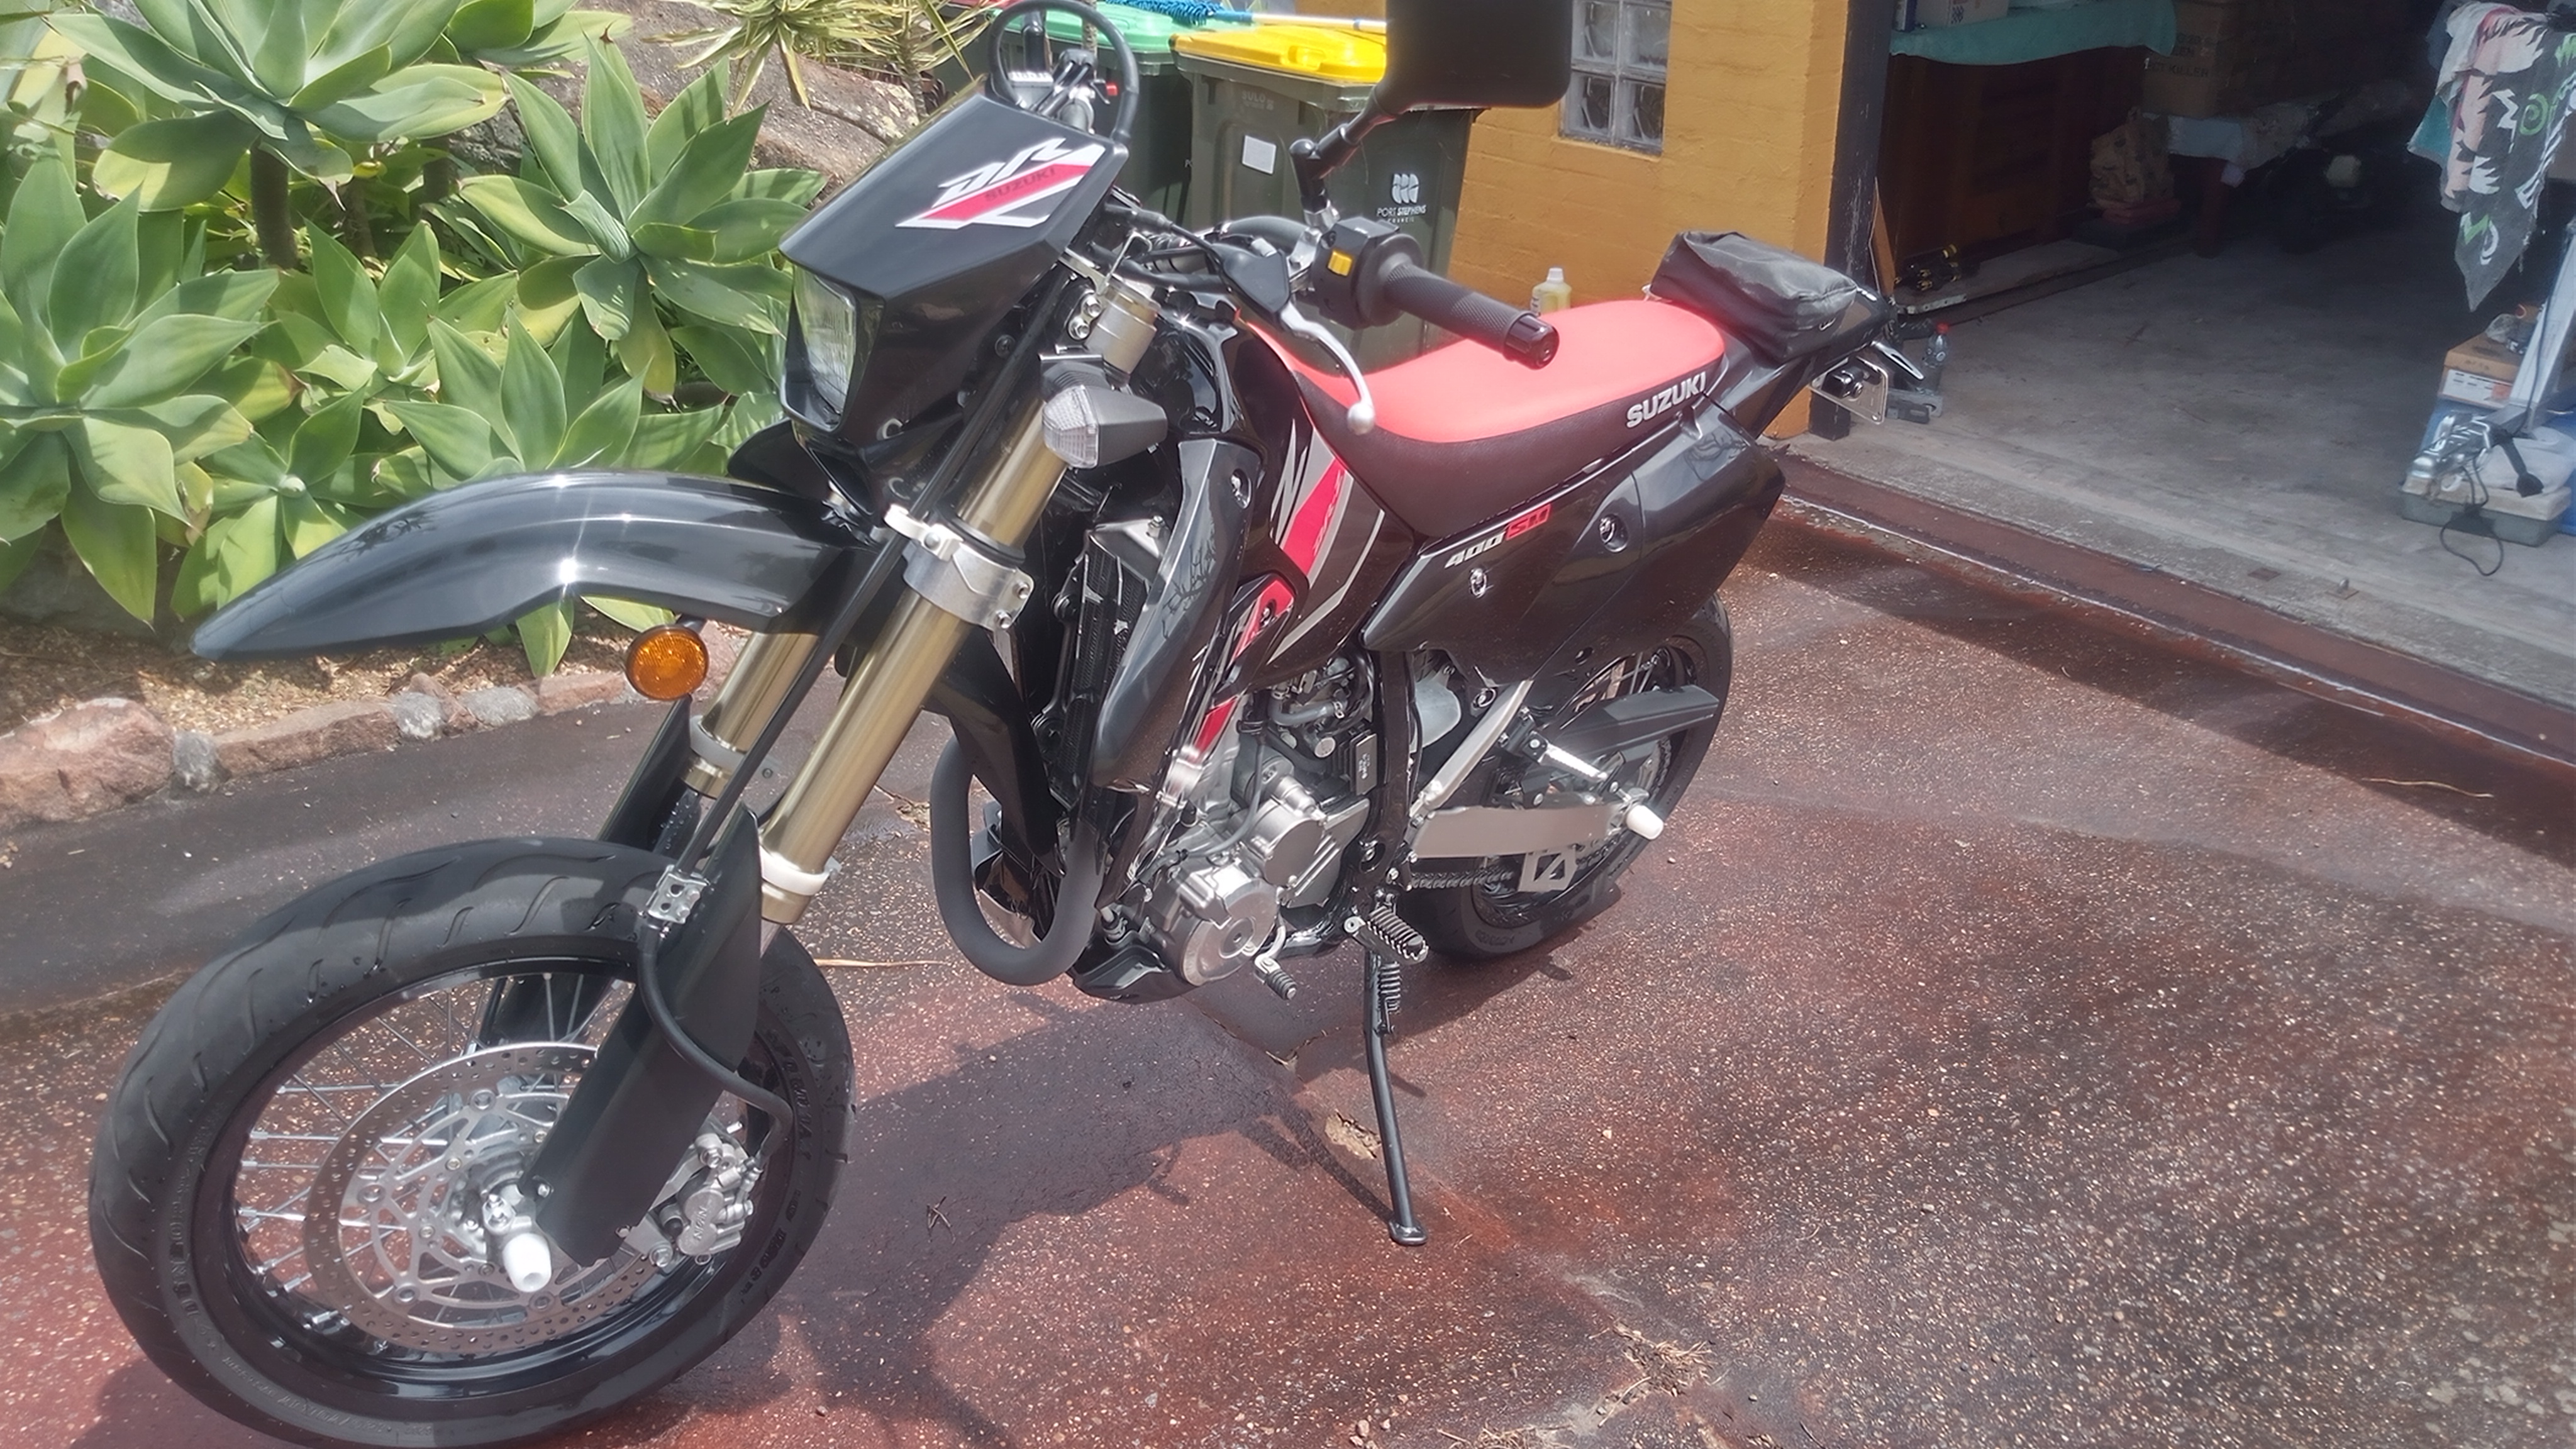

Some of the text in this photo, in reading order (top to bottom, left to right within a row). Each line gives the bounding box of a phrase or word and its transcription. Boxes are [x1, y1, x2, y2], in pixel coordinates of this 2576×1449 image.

[2169, 64, 2209, 78] KILLER
[1241, 90, 1266, 103] SULO
[984, 167, 1056, 202] SUZUKI
[1377, 204, 1426, 217] PORT STEPHENS
[1626, 371, 1706, 428] SUZUKI
